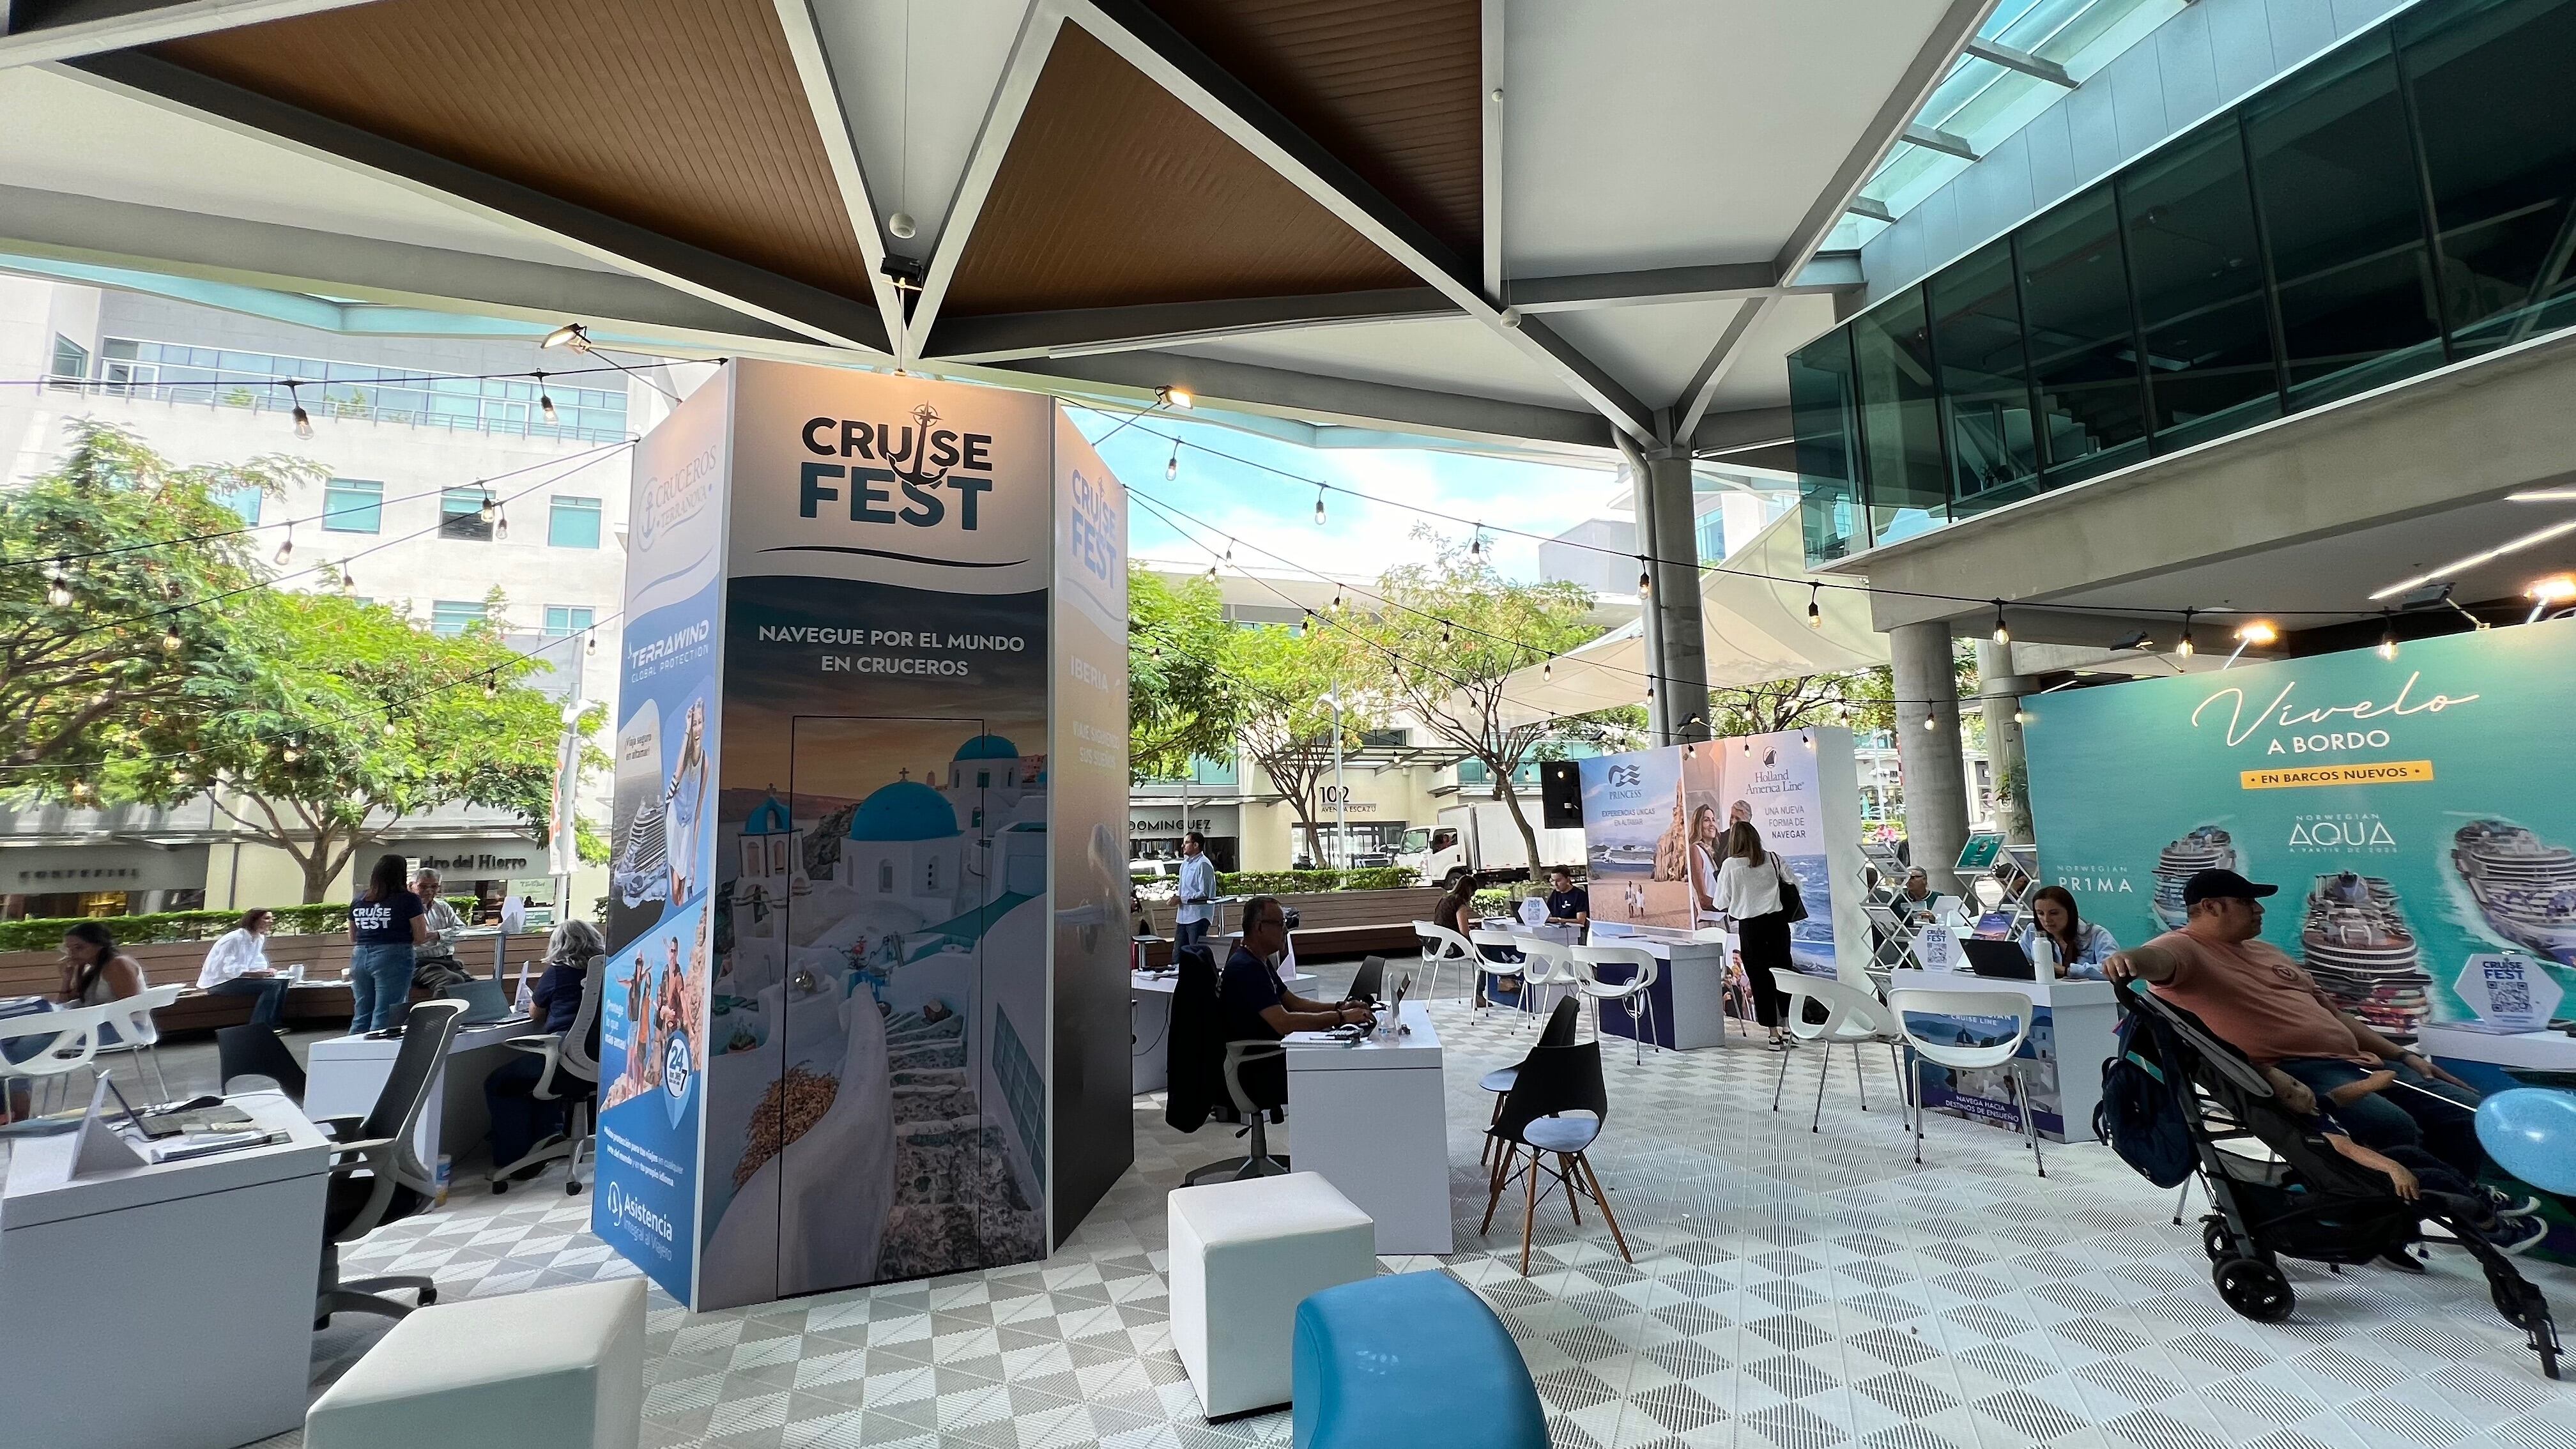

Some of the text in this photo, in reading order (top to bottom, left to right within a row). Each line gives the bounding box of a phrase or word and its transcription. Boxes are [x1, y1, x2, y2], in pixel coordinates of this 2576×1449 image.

[801, 414, 993, 473] CRUISE
[656, 445, 716, 508] CRUCEROS
[800, 461, 993, 530] FEST
[661, 485, 707, 528] TERRANOVA
[1072, 470, 1116, 542] CRUISE
[1071, 506, 1117, 589] FEST
[632, 619, 709, 670] TERRAWIND
[758, 625, 1025, 652] NAVEGUE POR EL MUNDO
[631, 643, 709, 683] GLOBAL PROTECTION
[821, 655, 969, 676] EN CRUCEROS
[1071, 656, 1108, 693] IBERIA
[2191, 670, 2480, 747] Vívelo
[2267, 729, 2391, 756] A BORDO
[1755, 769, 1790, 783] Holland
[2261, 767, 2408, 784] EN BARCOS NUEVOS
[1319, 786, 1349, 802] 102
[1609, 790, 1642, 800] PRINCESS
[1745, 783, 1781, 795] America
[1602, 809, 1636, 817] EXPERIENCIAS
[1765, 806, 1805, 816] UNA NUEVA
[1129, 819, 1211, 831] DOMINGUEZ
[1768, 818, 1805, 827] FORMA DE
[1772, 830, 1807, 839] NAVEGAR
[2289, 822, 2396, 846] AQUA
[452, 855, 473, 869] del
[479, 854, 527, 870] Hierro
[2057, 864, 2128, 873] NORWEGIAN
[2058, 876, 2133, 893] PR1MA
[353, 907, 392, 917] CRUISE
[355, 917, 392, 930] FEST
[2482, 961, 2524, 969] CRUISE
[2483, 969, 2524, 979] FEST
[1951, 1014, 1977, 1023] CRUISE
[1979, 1018, 1998, 1027] LINE
[670, 1046, 684, 1071] 24
[680, 1069, 688, 1092] 7
[1945, 1100, 2020, 1123] DESTINOS DE ENSUEÑO
[1956, 1095, 2006, 1112] NAVEGA HACIA
[624, 1193, 673, 1242] Asistencia
[624, 1215, 644, 1242] Integral
[650, 1232, 672, 1261] Viajero
